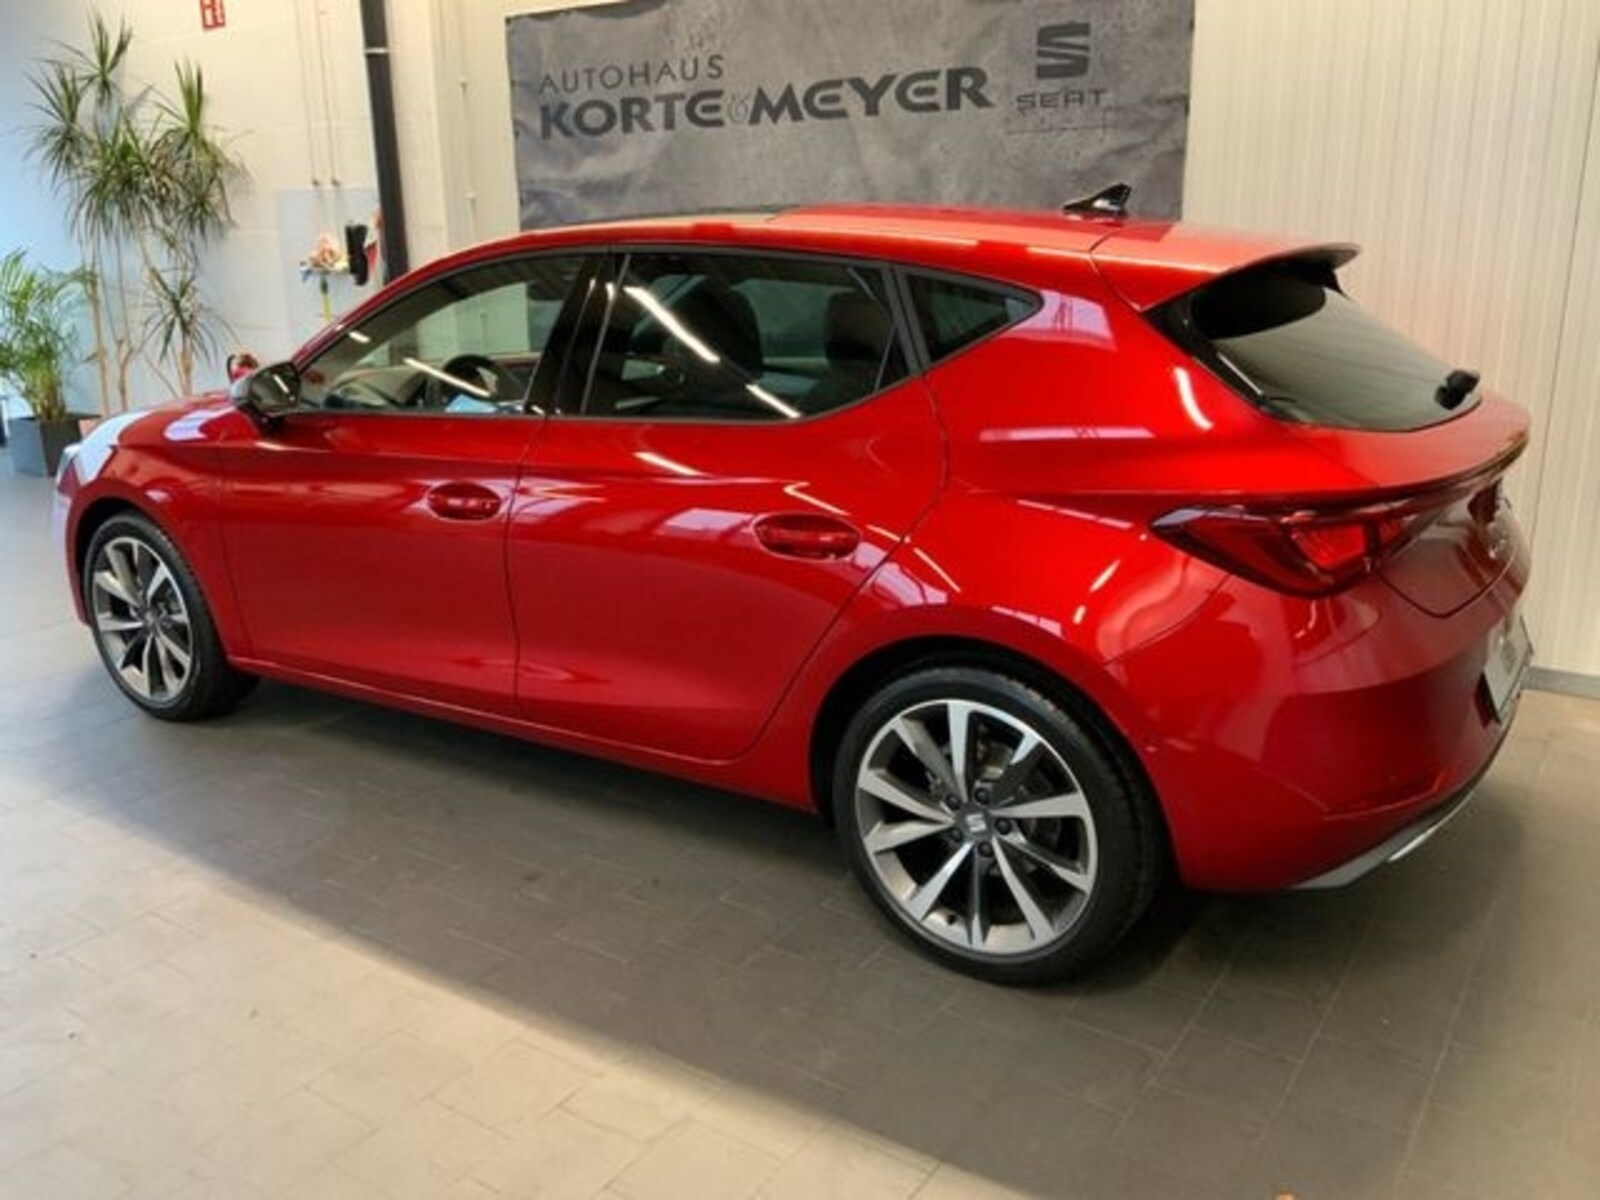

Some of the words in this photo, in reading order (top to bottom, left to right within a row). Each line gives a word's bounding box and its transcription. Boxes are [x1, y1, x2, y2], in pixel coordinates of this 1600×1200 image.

[539, 54, 725, 95] AUTOHAUS
[540, 89, 726, 141] KORTE
[748, 66, 996, 126] MEYER
[1016, 87, 1108, 113] SEAT
